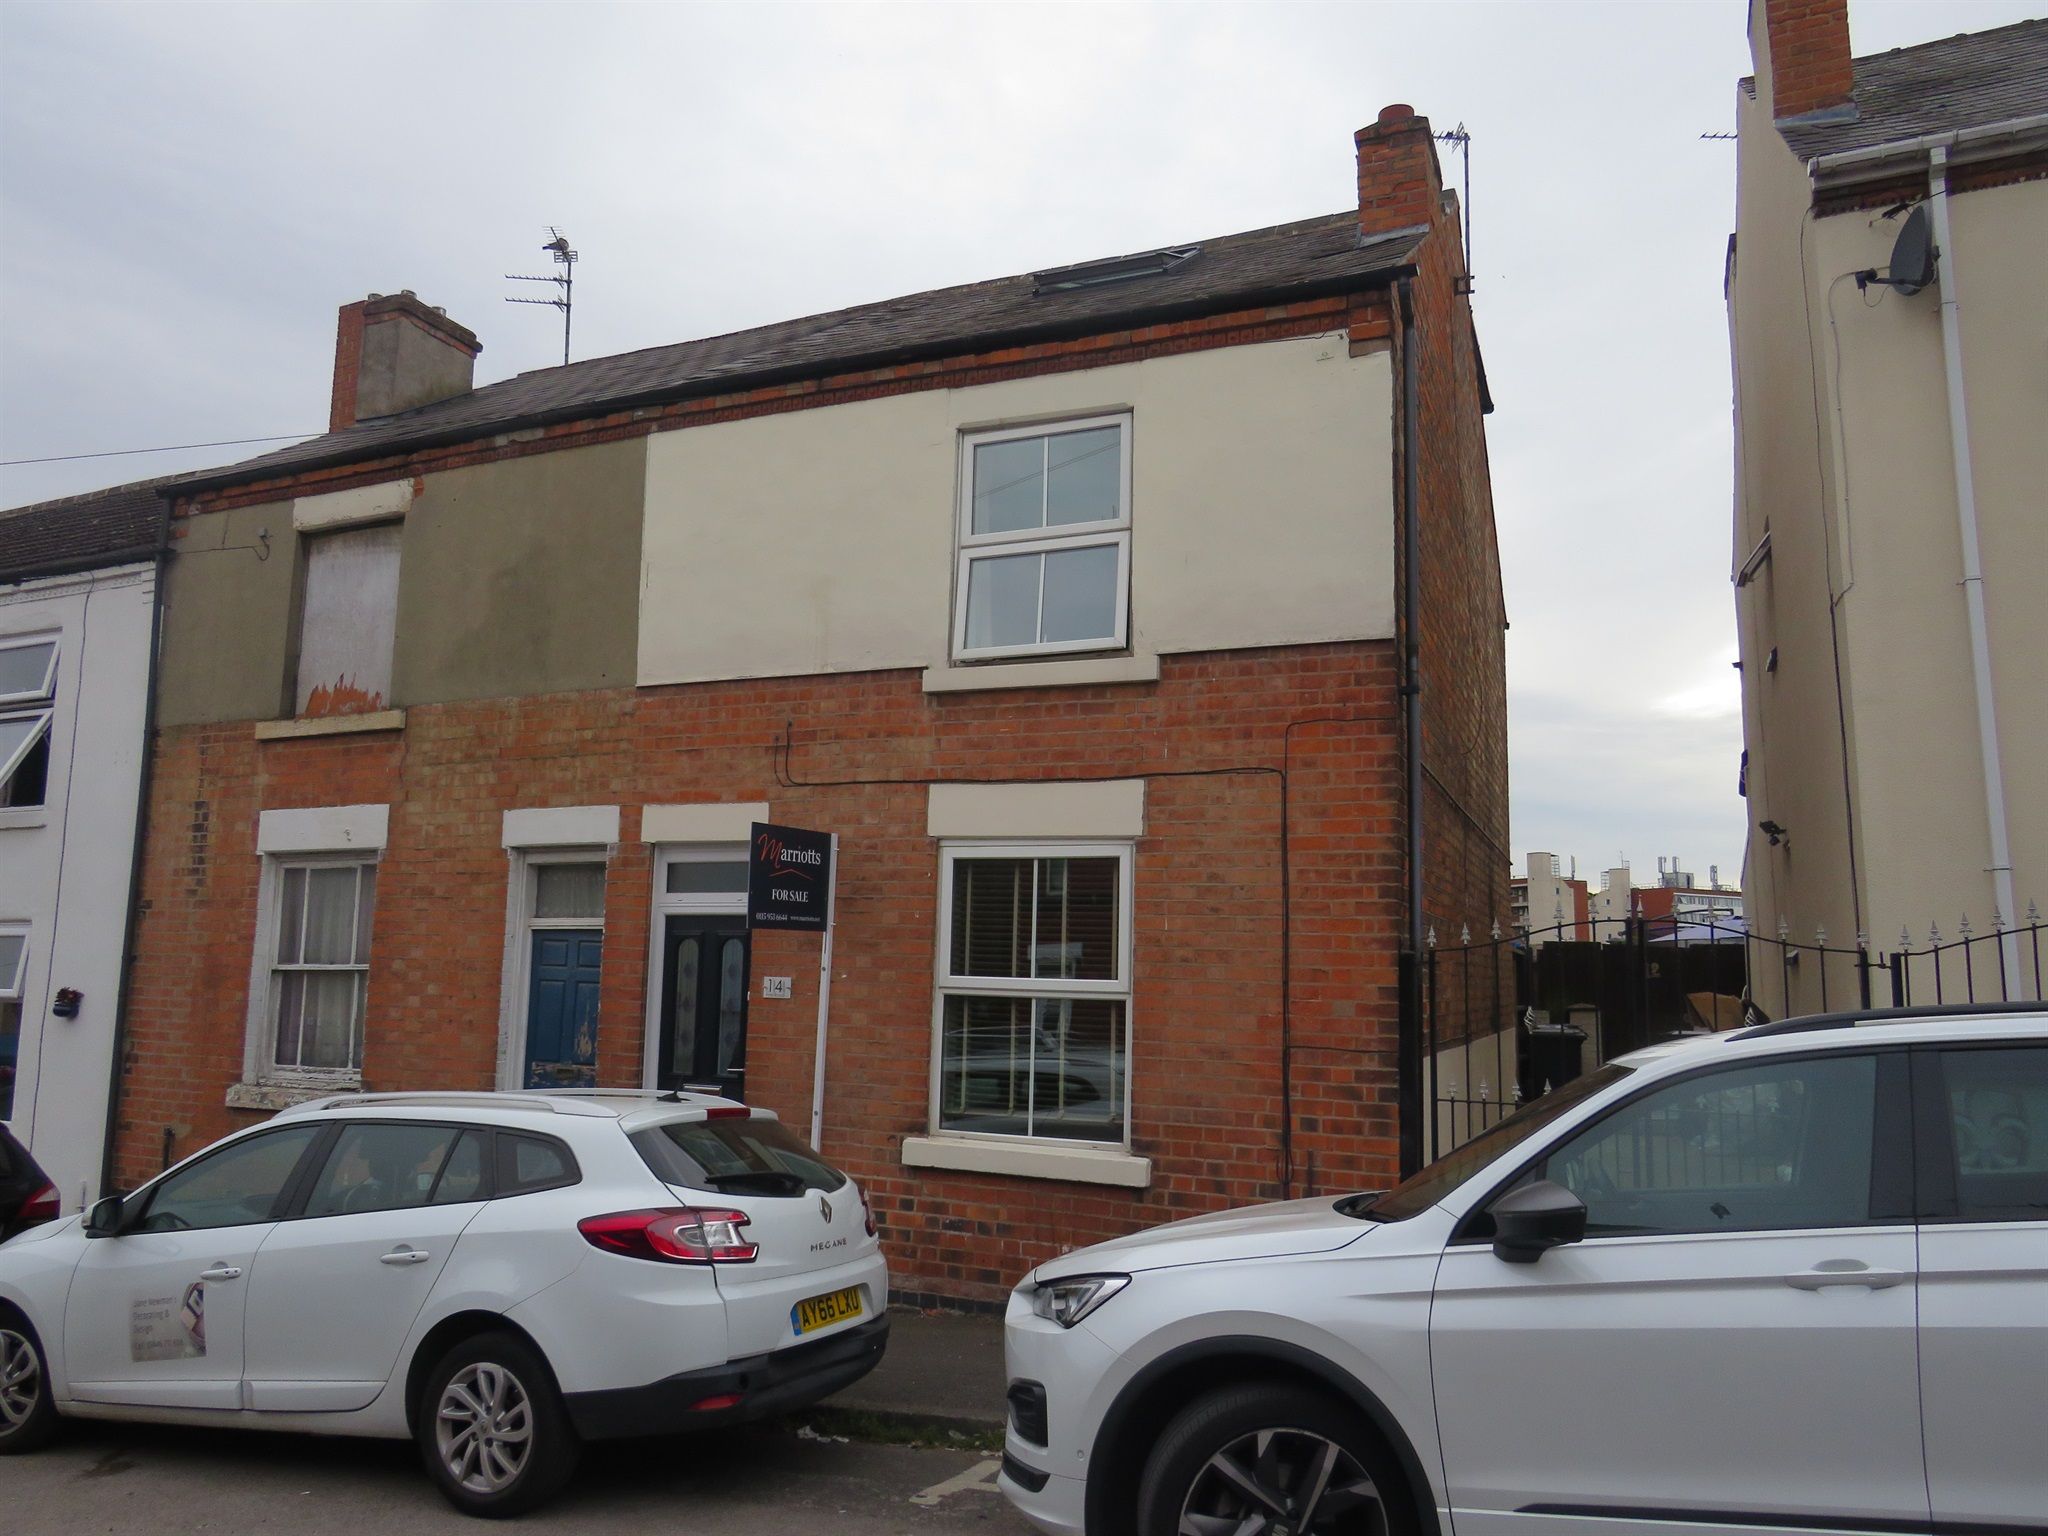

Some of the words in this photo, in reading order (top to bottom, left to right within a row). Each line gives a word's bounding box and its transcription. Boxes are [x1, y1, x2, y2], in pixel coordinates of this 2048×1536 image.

[758, 833, 821, 869] Marriotts
[772, 889, 788, 901] FOR
[789, 890, 809, 903] SALE
[769, 978, 783, 993] 14
[810, 1237, 848, 1252] MEGANE
[801, 1295, 836, 1328] AY66
[835, 1289, 860, 1315] LXU
